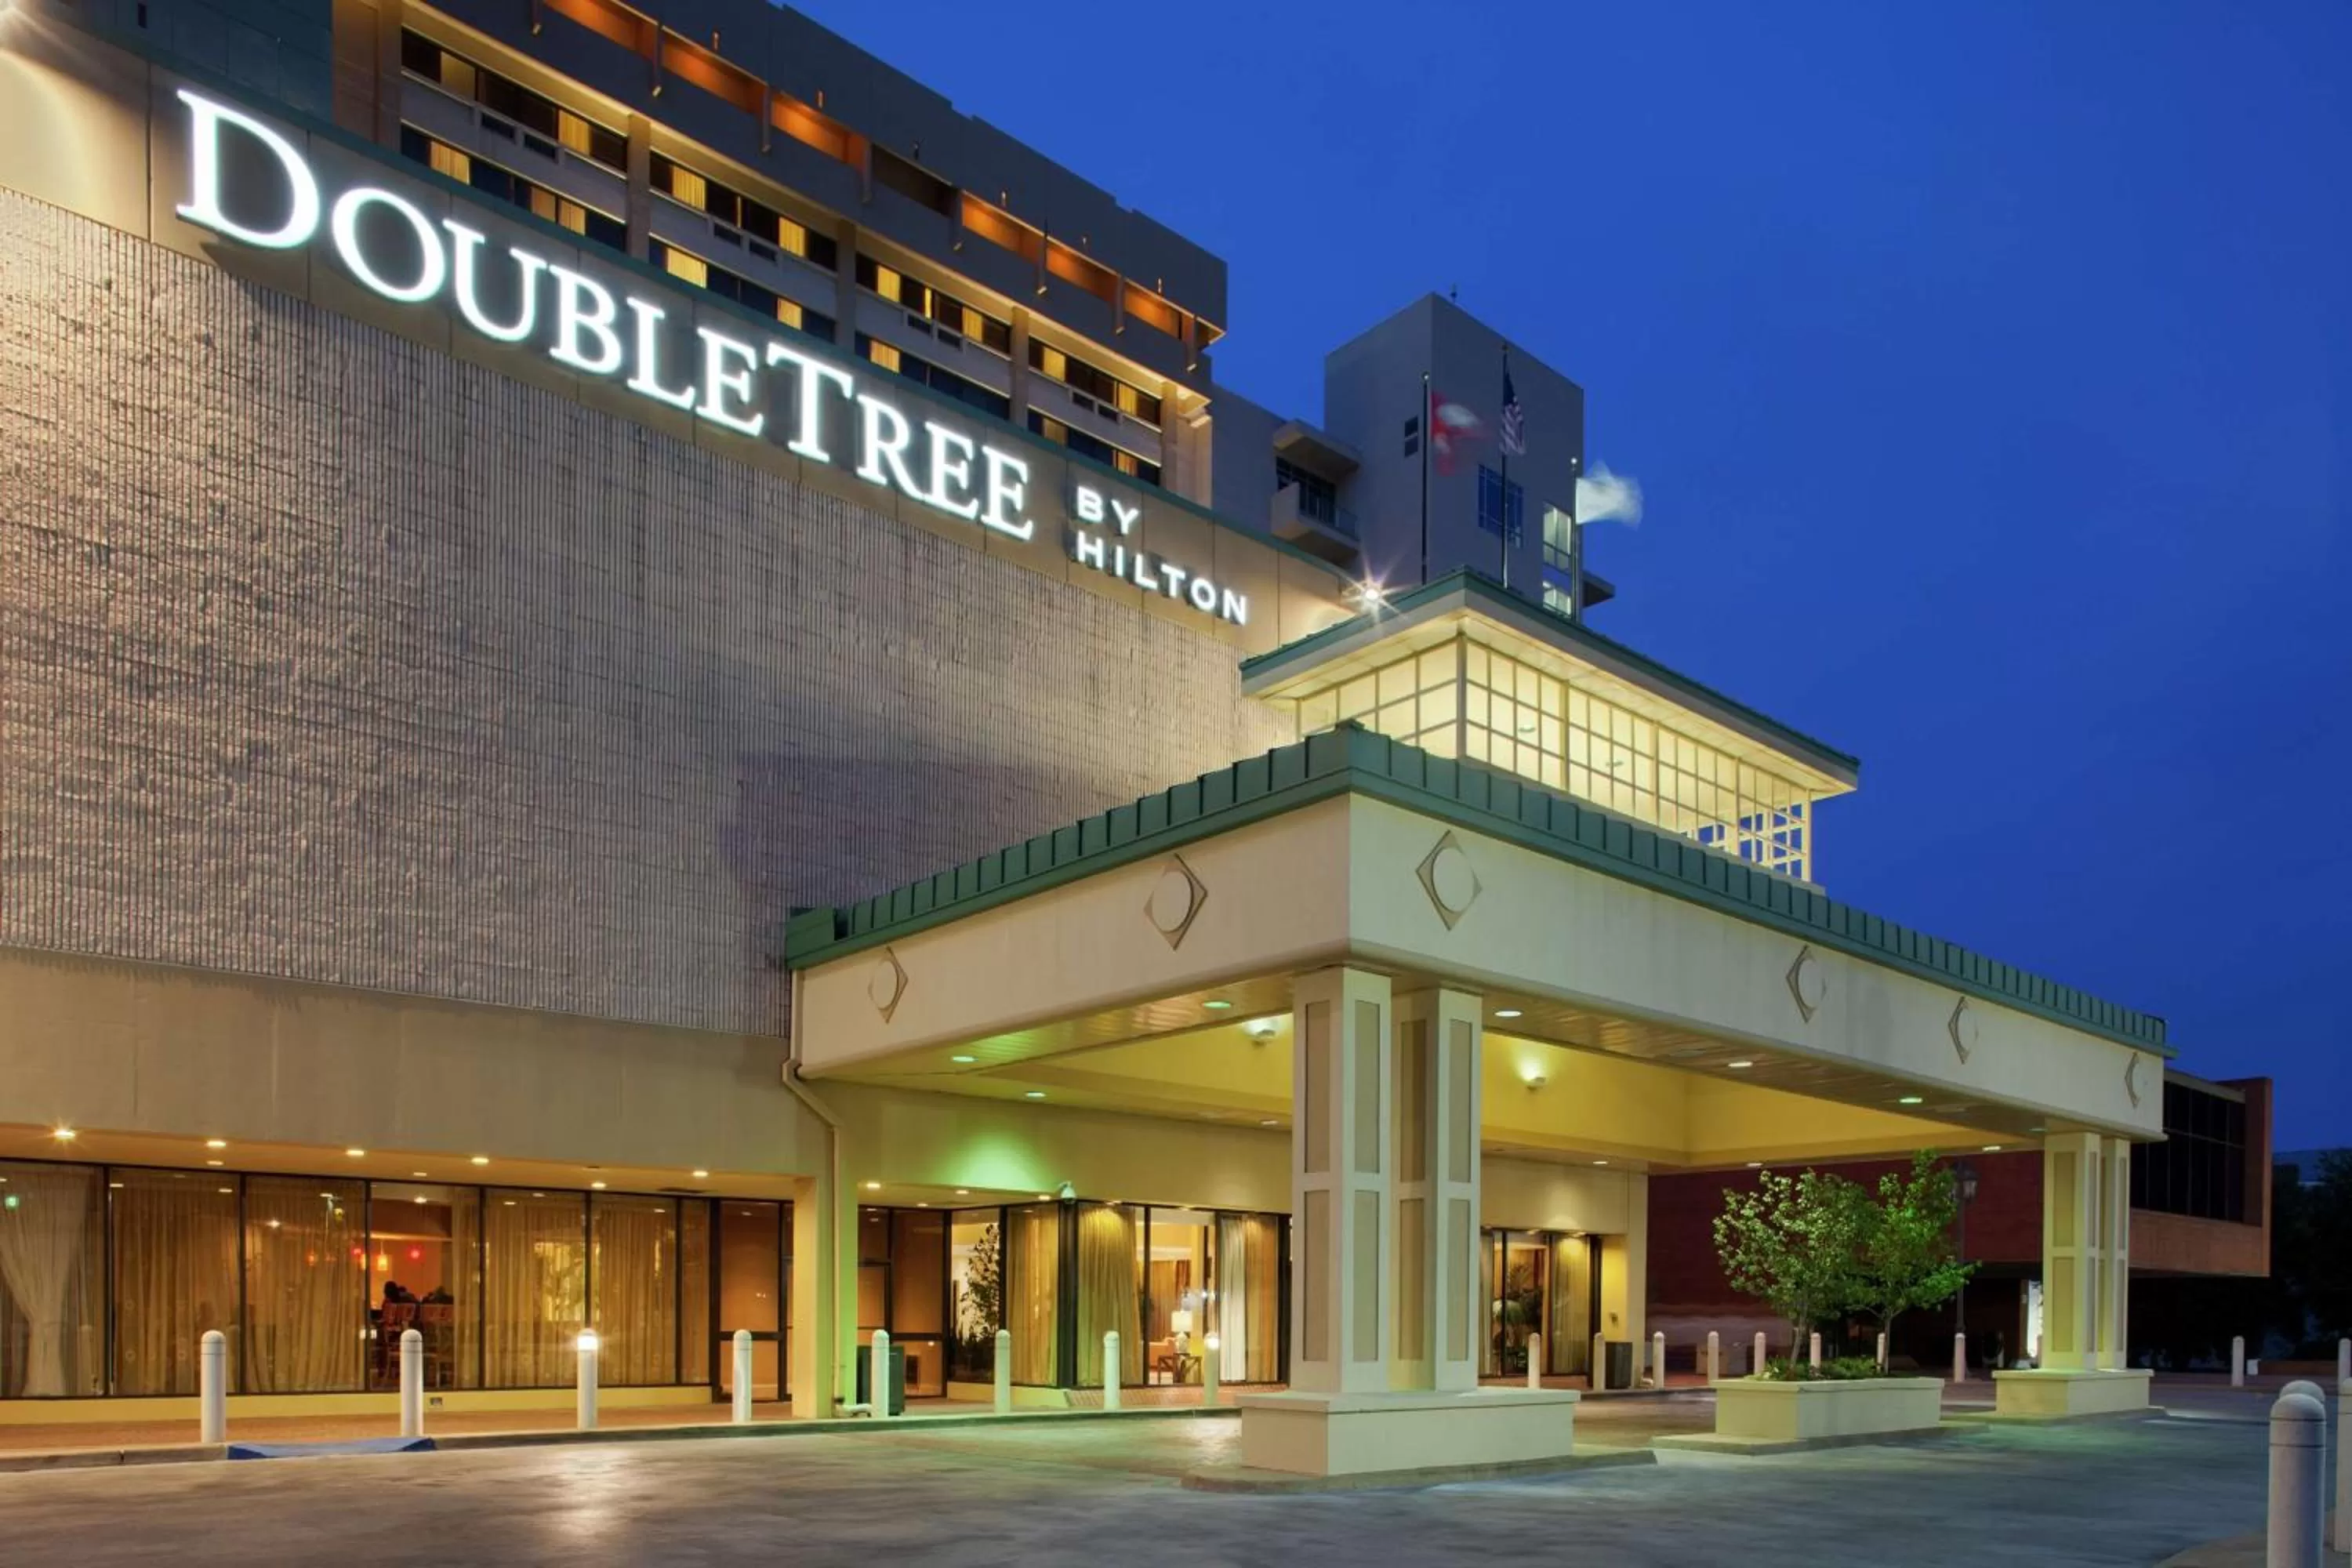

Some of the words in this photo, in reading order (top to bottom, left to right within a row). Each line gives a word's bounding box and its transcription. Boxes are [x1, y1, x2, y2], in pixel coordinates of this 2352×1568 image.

[175, 89, 1034, 541] DOUBLETREE
[1076, 485, 1140, 535] BY
[1076, 530, 1248, 626] HILTON
